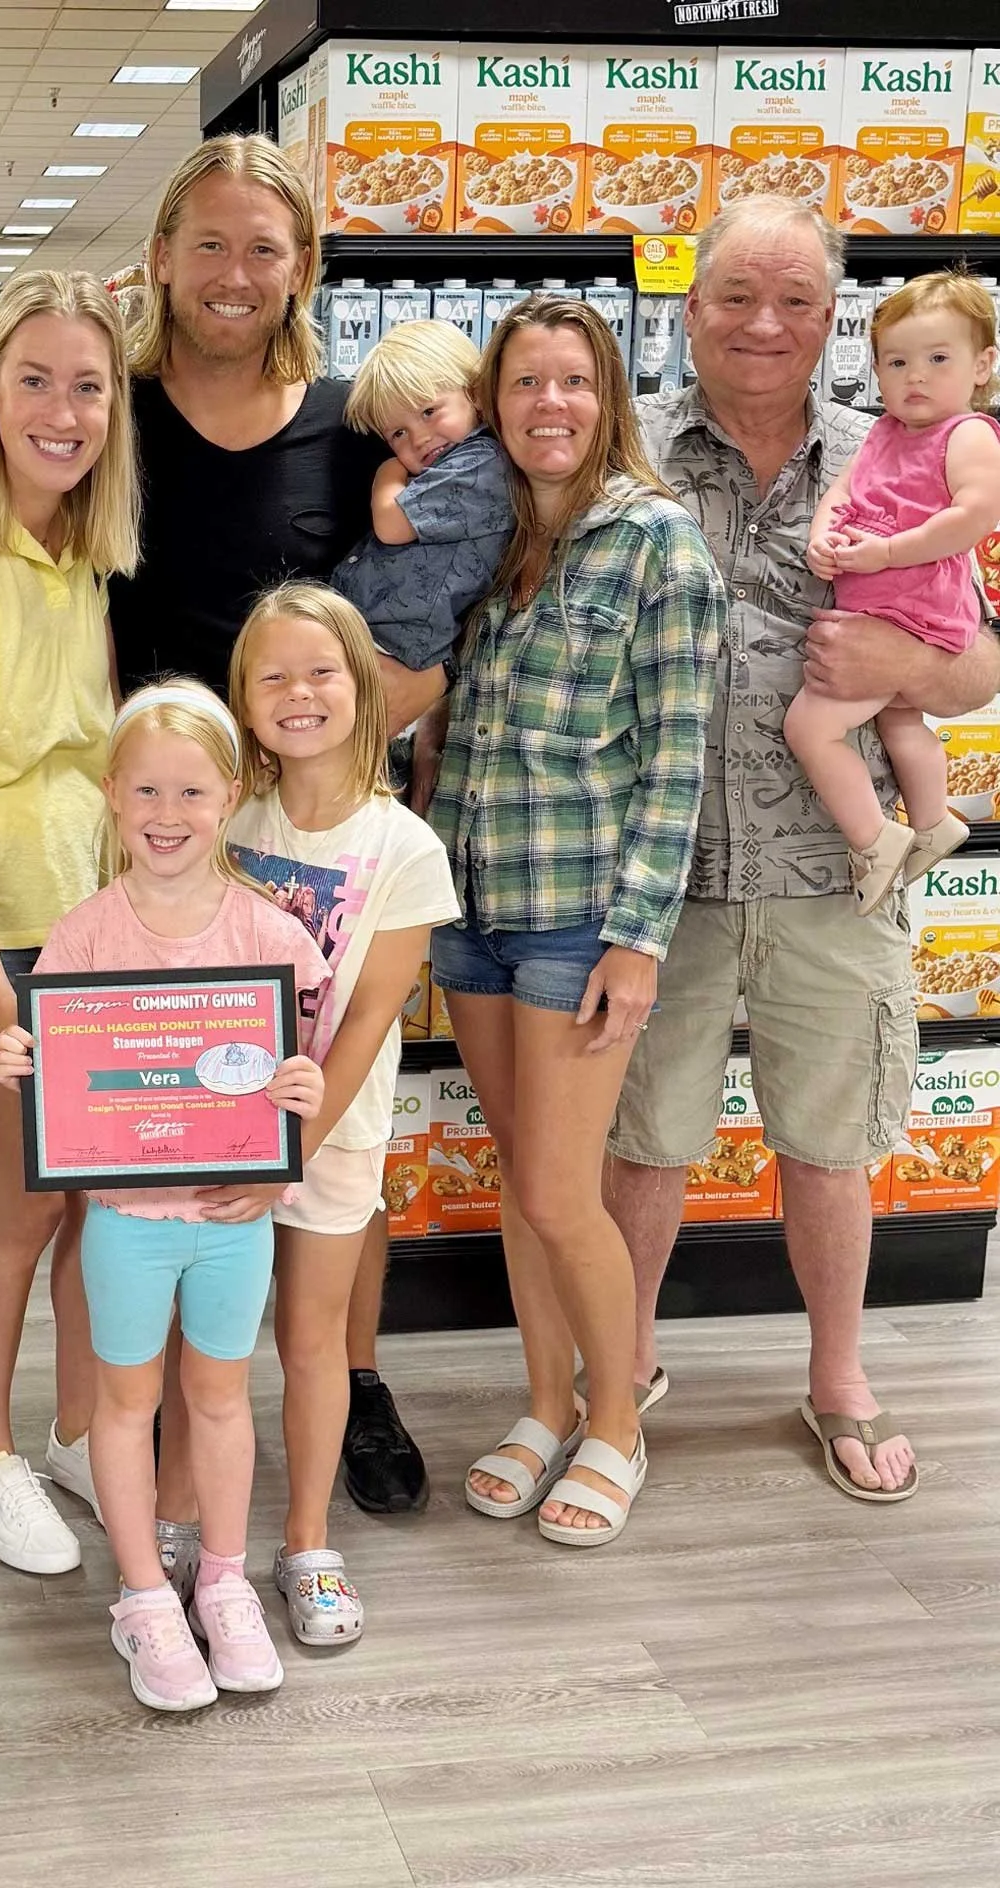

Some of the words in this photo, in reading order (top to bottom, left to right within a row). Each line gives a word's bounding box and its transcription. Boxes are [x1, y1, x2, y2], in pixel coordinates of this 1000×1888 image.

[677, 1, 740, 21] NORTHWEST
[742, 0, 776, 16] FRESH
[346, 51, 442, 86] Kashi
[476, 54, 572, 88] Kashi
[605, 57, 699, 89] Kashi
[734, 59, 827, 91] Kashi
[861, 60, 953, 92] Kashi
[379, 90, 409, 101] maple
[508, 92, 539, 103] maple
[636, 94, 667, 104] maple
[764, 95, 795, 106] maple
[891, 97, 921, 107] maple
[371, 101, 395, 110] waffle
[397, 101, 417, 110] bites
[501, 103, 526, 112] waffle
[527, 103, 547, 112] bites
[629, 104, 655, 113] waffle
[655, 104, 674, 113] bites
[757, 106, 782, 114] waffle
[782, 106, 801, 114] bites
[883, 107, 908, 116] waffle
[908, 107, 927, 116] bites
[646, 243, 663, 254] SALE
[340, 321, 371, 340] LY!
[836, 318, 866, 337] LY!
[924, 868, 1000, 897] Kash
[924, 908, 952, 919] honey
[953, 906, 981, 918] hearts
[58, 998, 130, 1014] Haggen
[132, 994, 210, 1012] COMMUNITY
[211, 992, 257, 1009] GIVING
[49, 1025, 104, 1036] OFFICIAL
[106, 1023, 157, 1034] HAGGEN
[159, 1020, 202, 1031] DONUT
[204, 1018, 267, 1029] INVENTOR
[112, 1036, 163, 1050] Stanwood
[165, 1036, 204, 1050] Haggen
[139, 1070, 180, 1086] Vera
[88, 1104, 114, 1113] Design
[115, 1104, 133, 1112] Your
[134, 1103, 159, 1111] Dream
[160, 1102, 184, 1110] Donut
[185, 1101, 215, 1109] Contest
[727, 1101, 745, 1113] 10g
[934, 1102, 951, 1114] 10g
[956, 1100, 973, 1112] 10g
[128, 1118, 194, 1133] Haggen
[705, 1190, 731, 1200] butter
[732, 1190, 759, 1199] crunch
[442, 1201, 470, 1212] peanut
[471, 1200, 496, 1210] butter
